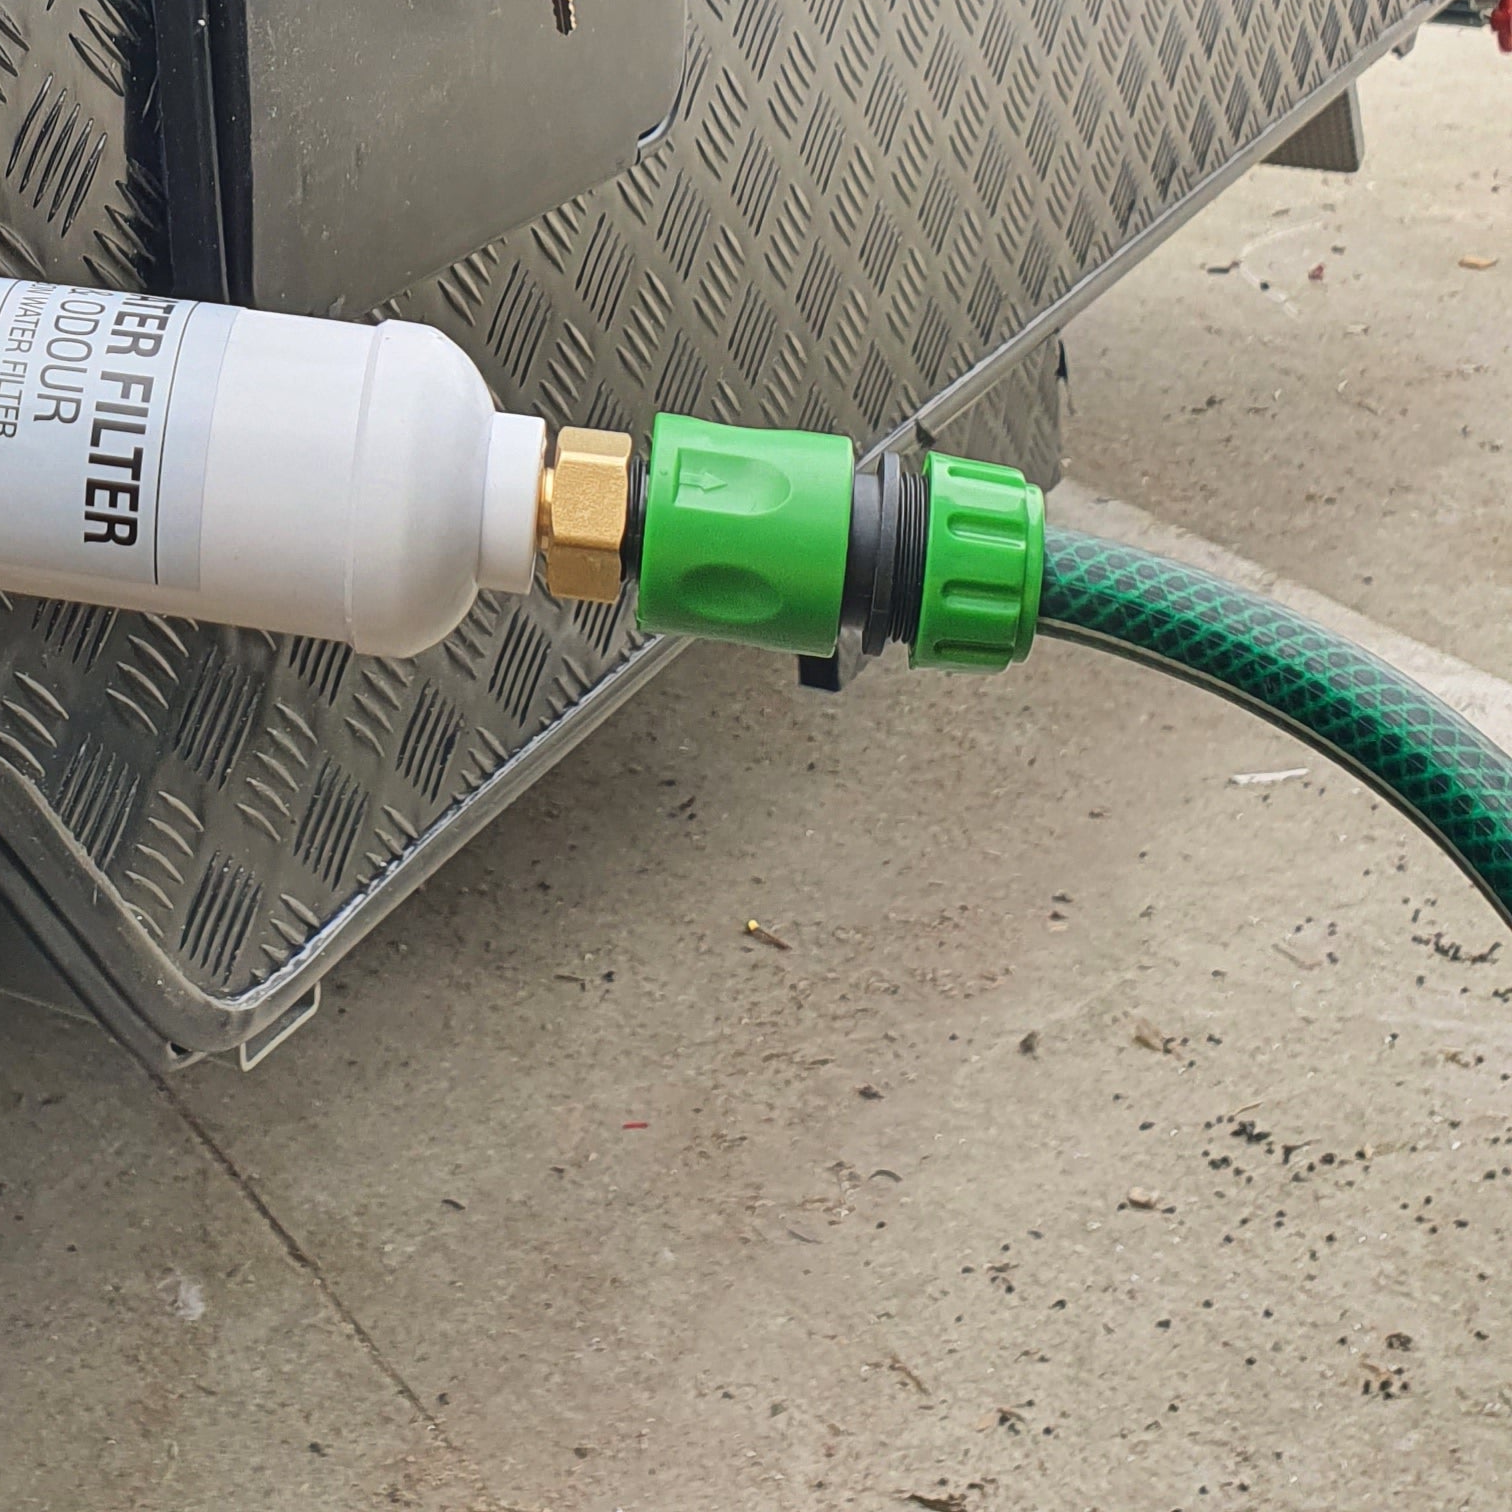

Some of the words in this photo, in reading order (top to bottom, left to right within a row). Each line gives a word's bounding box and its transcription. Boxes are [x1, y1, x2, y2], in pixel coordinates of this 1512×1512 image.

[5, 296, 50, 354] WATER
[33, 299, 106, 424] ODOUR
[105, 292, 179, 358] ATER
[83, 370, 155, 547] FILTER
